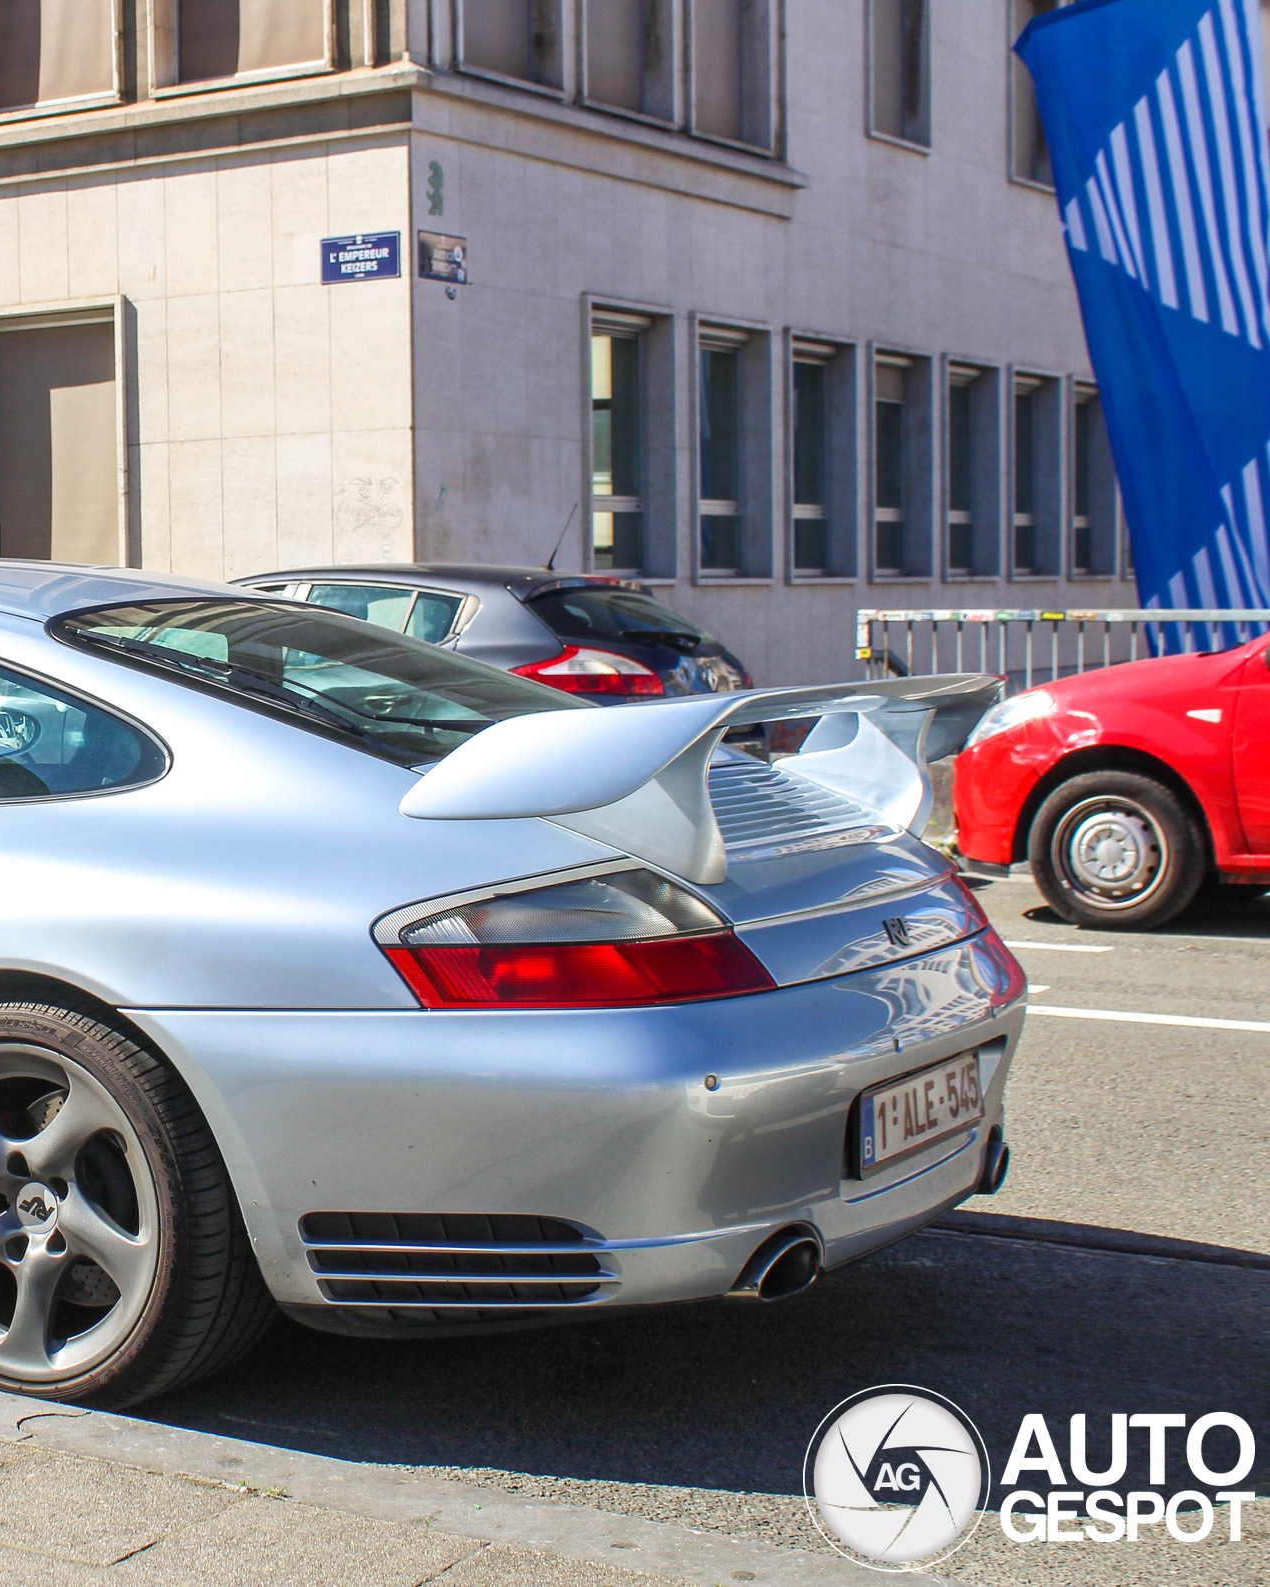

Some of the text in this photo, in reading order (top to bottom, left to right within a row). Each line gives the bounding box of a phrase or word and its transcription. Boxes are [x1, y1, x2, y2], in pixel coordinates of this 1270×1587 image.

[338, 247, 390, 262] EMPEREUR
[341, 260, 379, 274] KEIZERS
[864, 1136, 873, 1159] B
